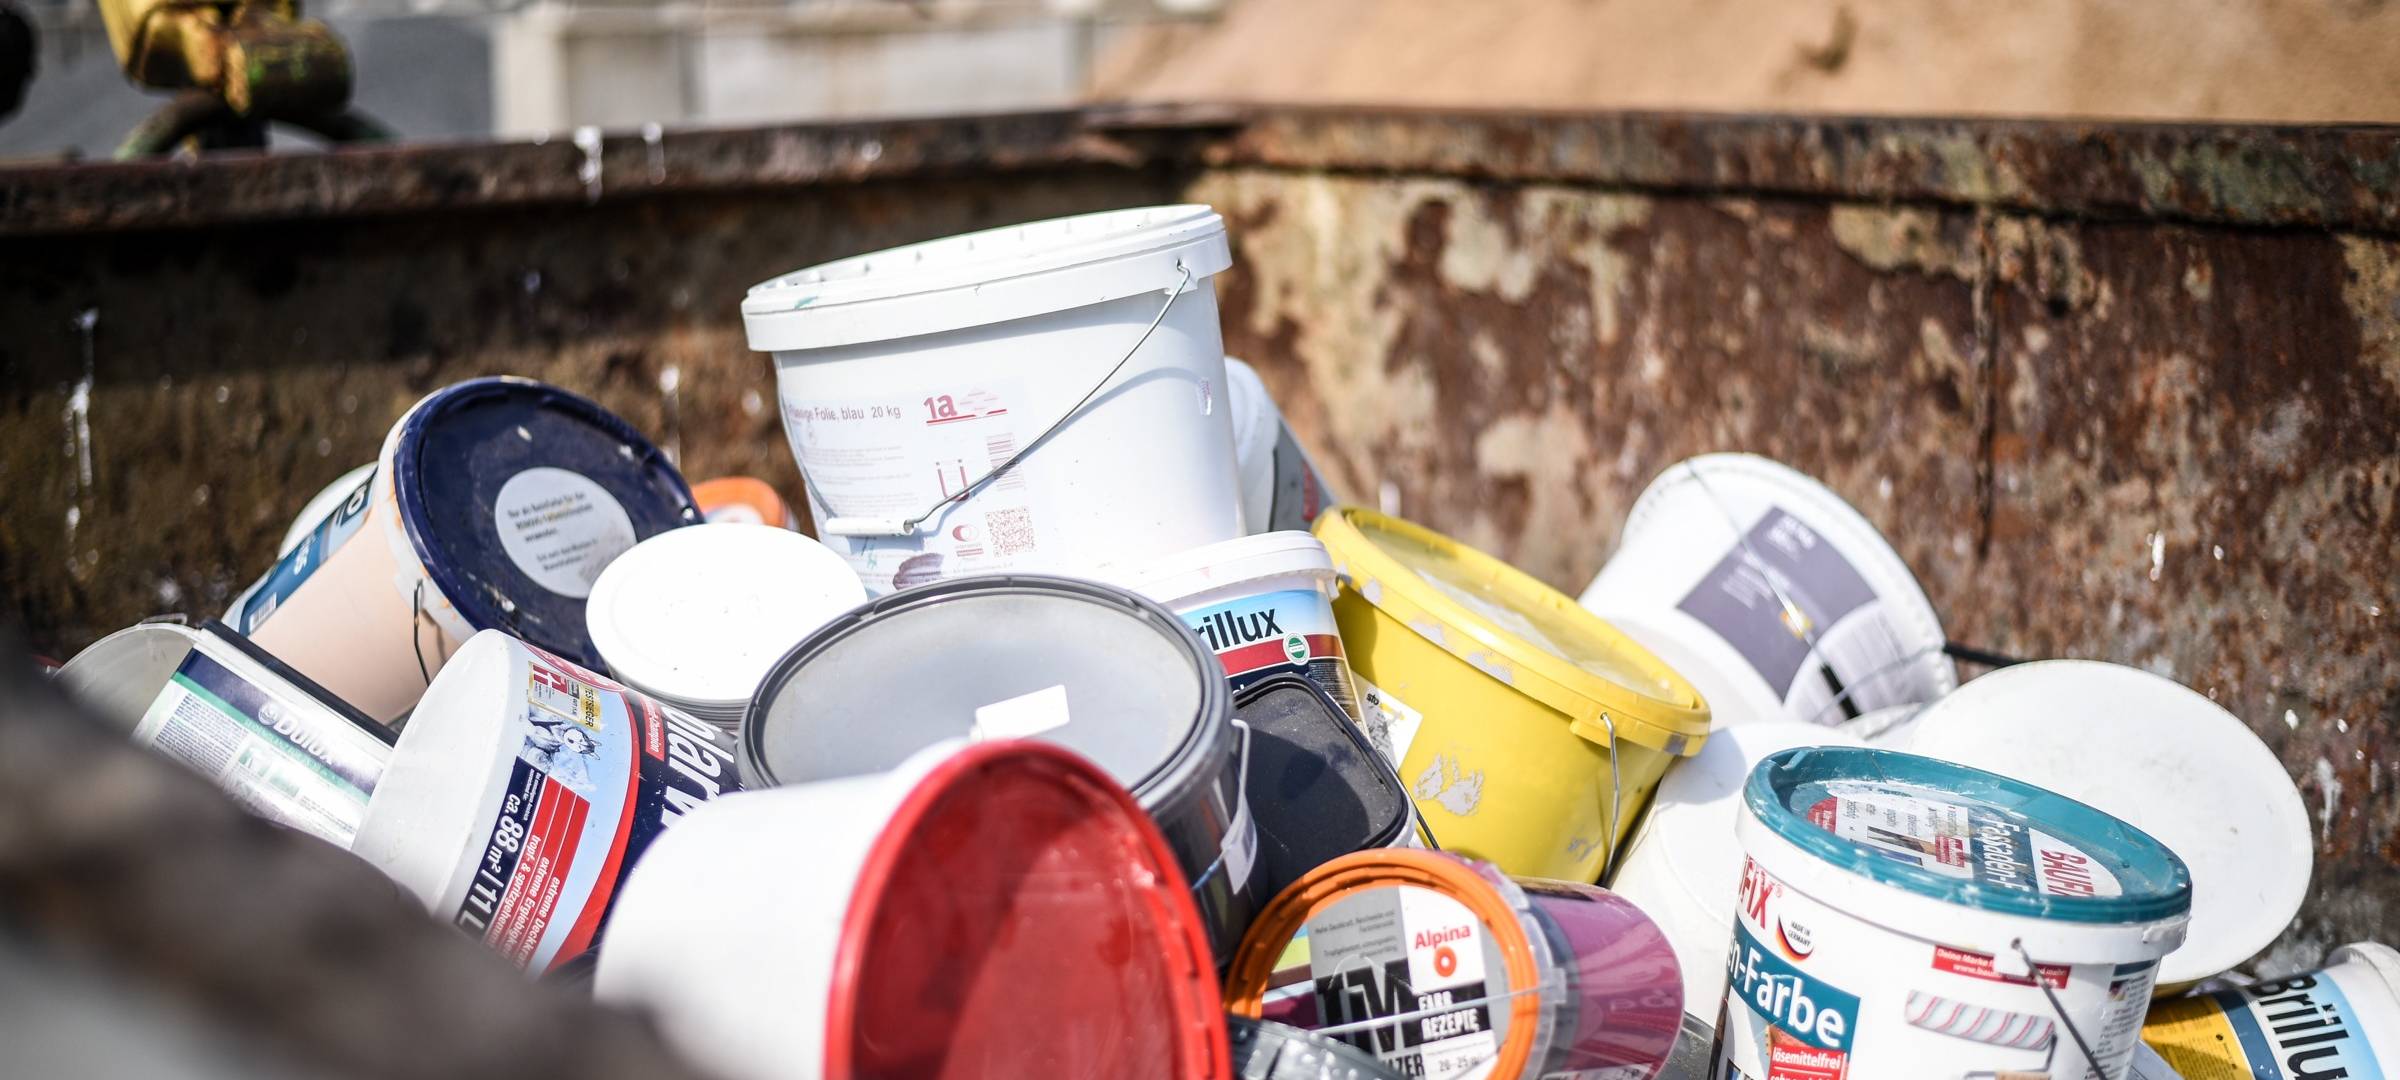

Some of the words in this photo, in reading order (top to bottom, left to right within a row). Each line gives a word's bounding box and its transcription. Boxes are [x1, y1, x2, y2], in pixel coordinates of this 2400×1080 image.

[842, 407, 865, 420] blau
[872, 405, 884, 418] 20
[887, 404, 902, 419] kg
[923, 394, 958, 419] 1a
[585, 687, 595, 728] TESTSIEGER
[1366, 693, 1380, 706] sto
[506, 793, 521, 814] ca.
[495, 815, 524, 853] 88
[529, 856, 550, 897] extreme
[469, 883, 498, 915] 11
[541, 876, 561, 918] extreme
[1414, 924, 1472, 951] Alpina
[1787, 929, 1811, 947] GERMANY
[1421, 1008, 1480, 1041] REZEPTE
[1772, 1046, 1842, 1069] lösemittelfrei
